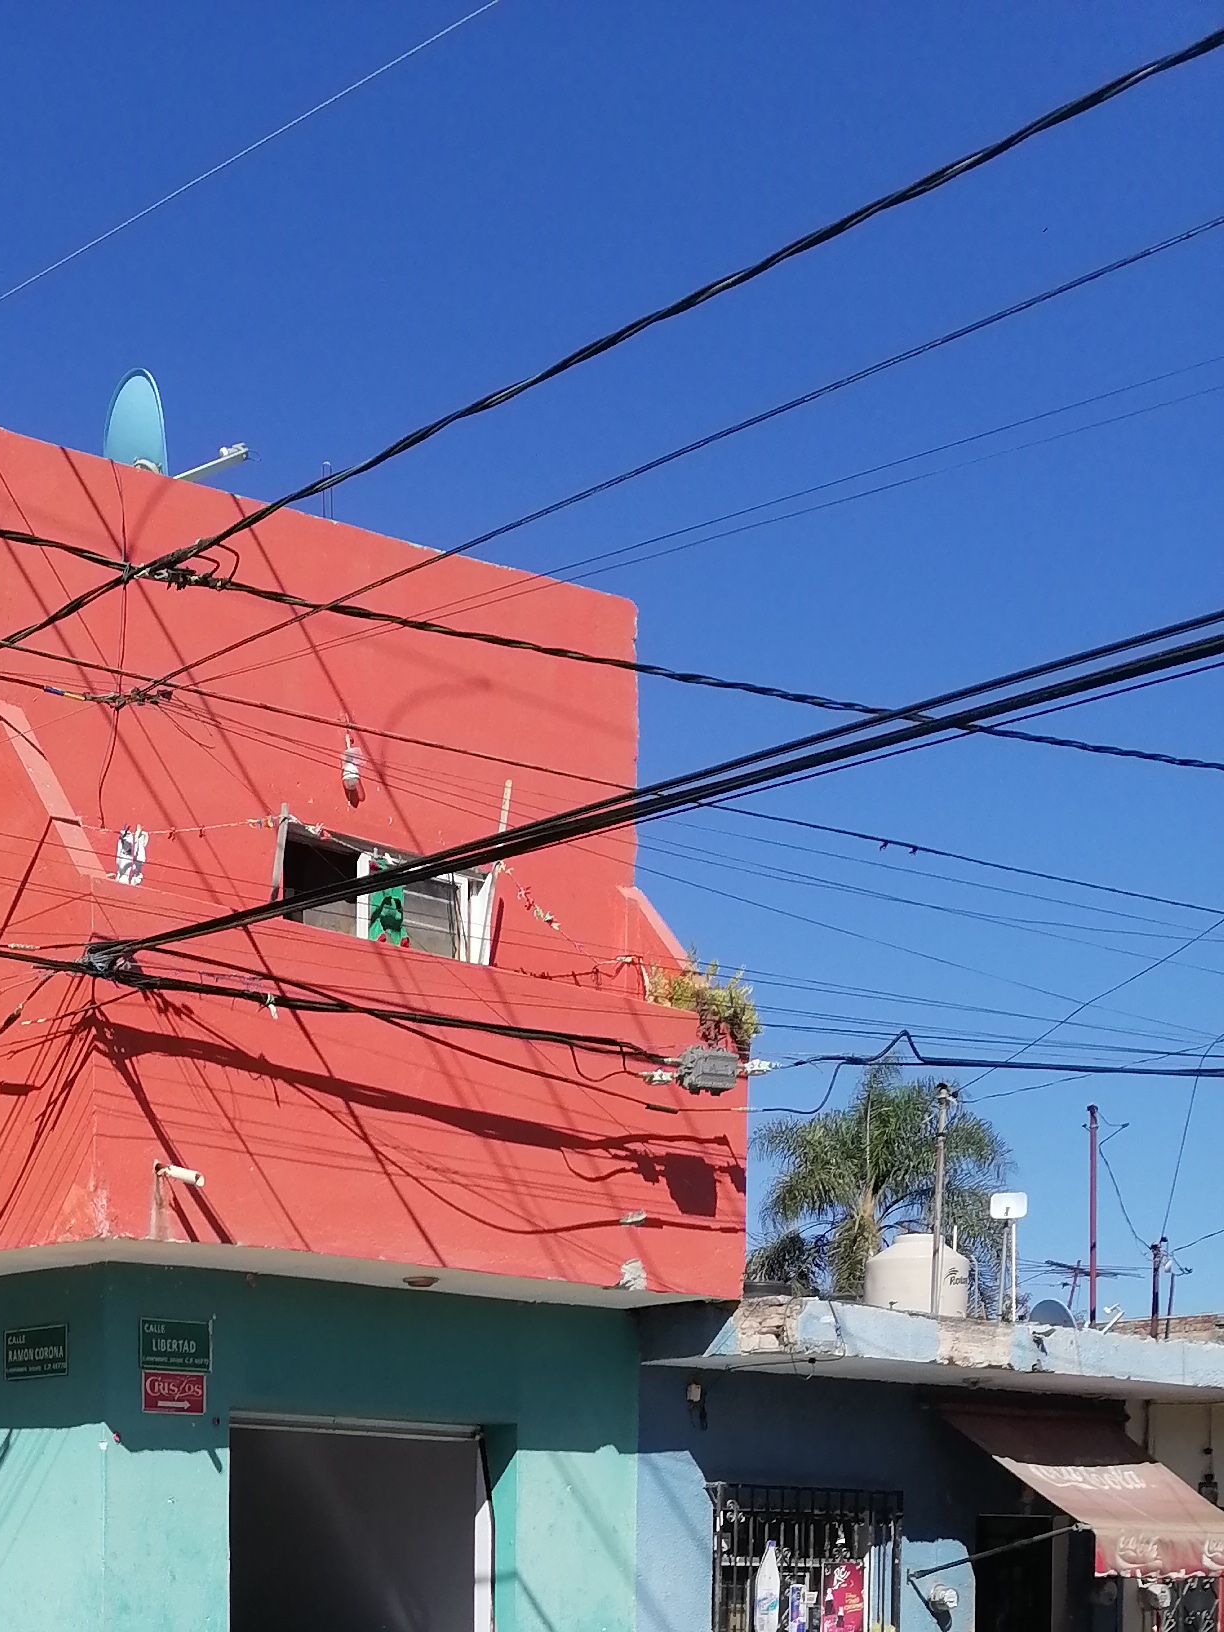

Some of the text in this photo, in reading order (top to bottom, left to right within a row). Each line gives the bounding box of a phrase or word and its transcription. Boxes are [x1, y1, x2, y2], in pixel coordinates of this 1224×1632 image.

[144, 1324, 165, 1334] CALLE
[8, 1334, 26, 1345] CALLE
[152, 1338, 196, 1354] LIBERTAD
[8, 1345, 64, 1362] RAMON CORONA
